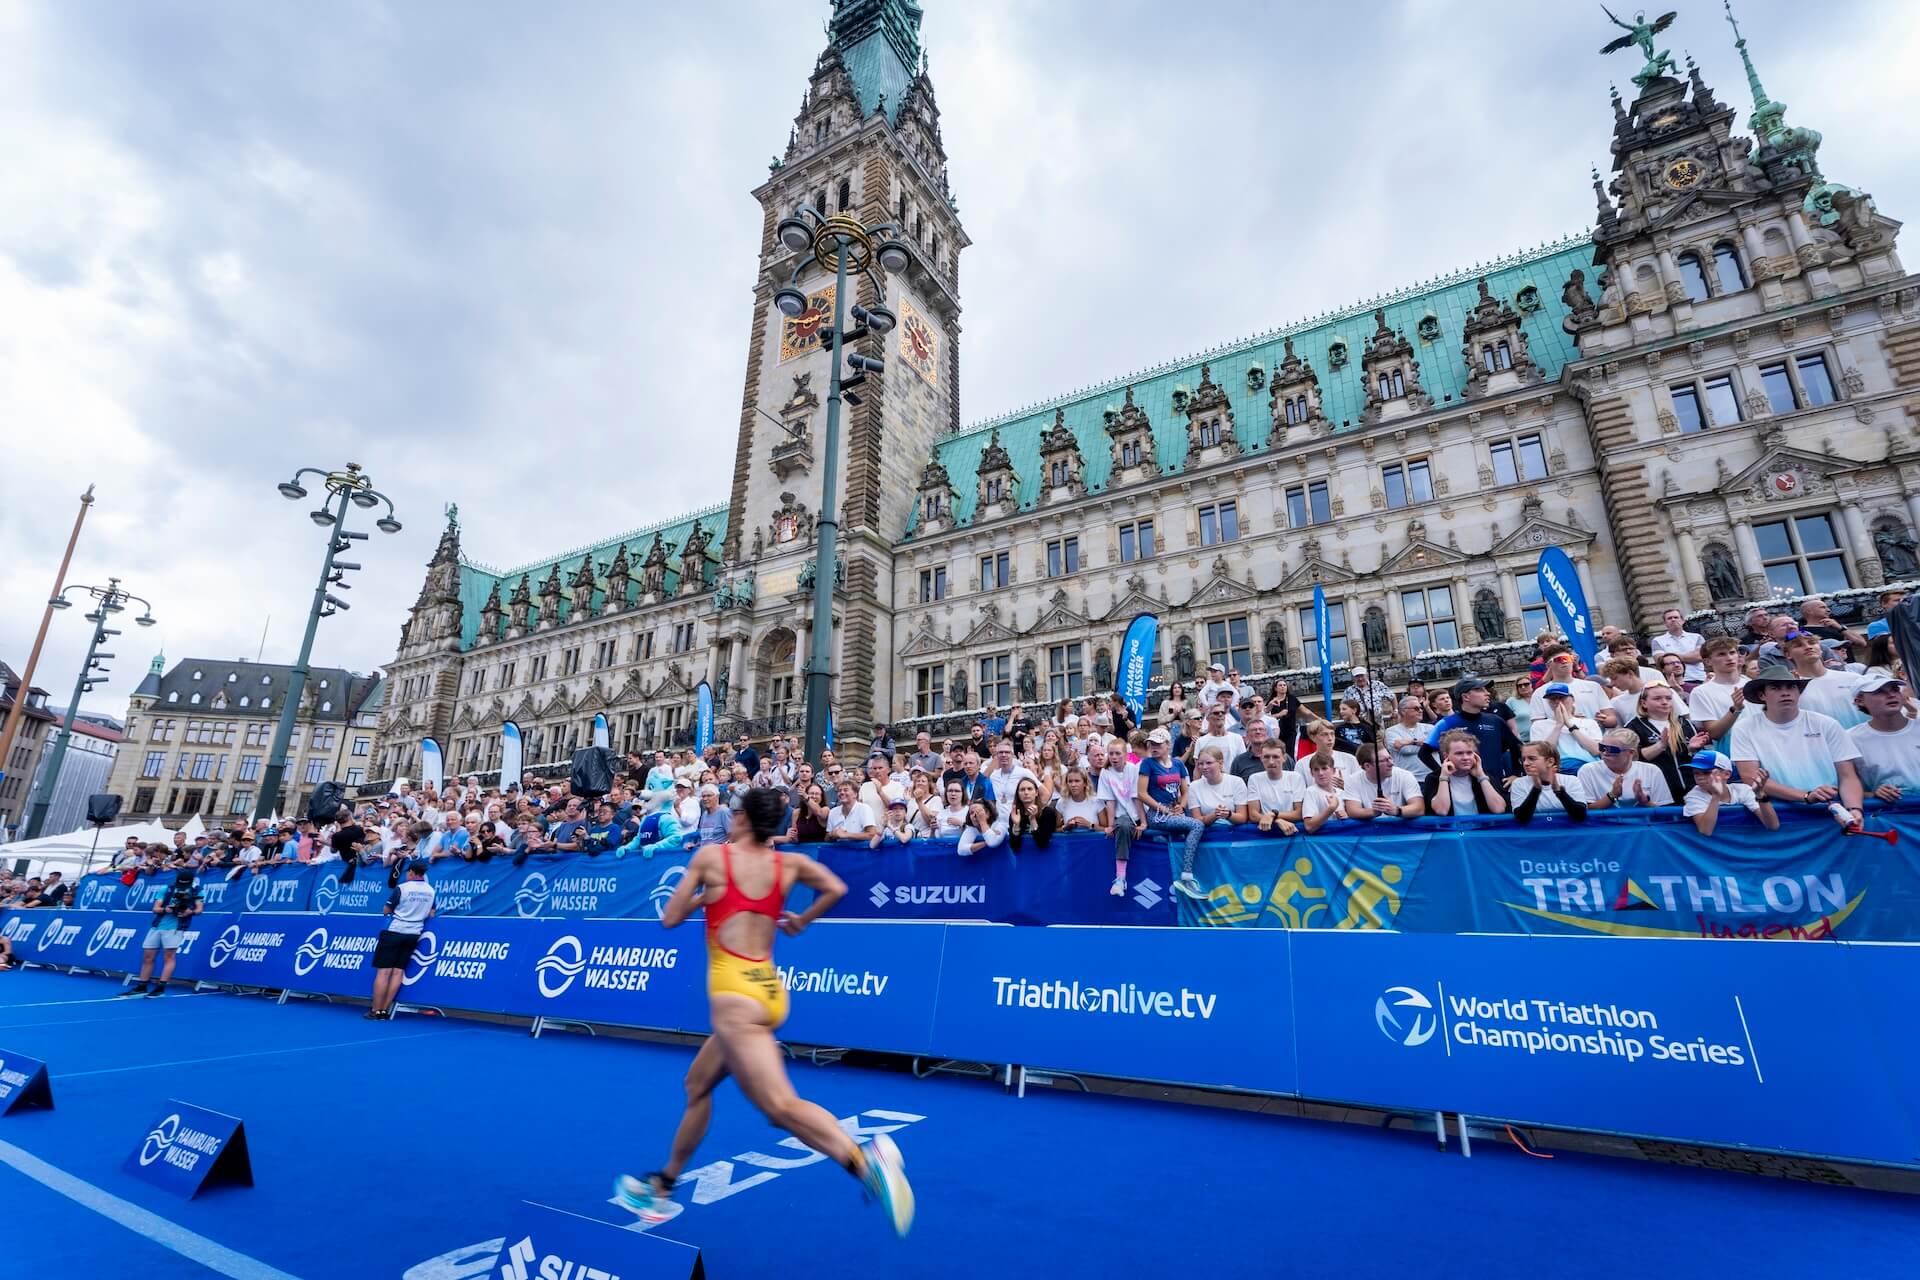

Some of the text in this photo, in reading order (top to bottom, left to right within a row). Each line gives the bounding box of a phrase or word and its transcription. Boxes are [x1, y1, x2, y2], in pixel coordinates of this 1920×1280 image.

[1125, 640, 1140, 697] HAMBURG
[1133, 655, 1145, 697] WASSER
[1519, 857, 1621, 875] Deutsche
[94, 885, 117, 903] NTT
[267, 879, 299, 903] NTT
[434, 879, 490, 894] HAMBURG
[552, 877, 617, 893] HAMBURG
[894, 885, 986, 904] SUZUKI
[1522, 872, 1847, 914] TRIATHLON
[339, 894, 369, 907] WASSER
[551, 895, 598, 912] WASSER
[53, 925, 83, 946] NTT
[104, 927, 137, 950] NTT
[240, 932, 286, 947] HAMBURG
[233, 947, 268, 963] WASSER
[322, 952, 364, 970] WASSER
[441, 940, 511, 960] HAMBURG
[589, 946, 679, 969] HAMBURG
[434, 960, 487, 980] WASSER
[584, 968, 650, 991] WASSER
[776, 965, 889, 996] hlonlive.tv
[992, 976, 1217, 1019] Triathlonlive.tv
[1449, 996, 1658, 1029] World Triathlon
[1453, 1021, 1745, 1066] Championship Series
[174, 1127, 222, 1156] HAMBURG
[163, 1145, 200, 1172] WASSER
